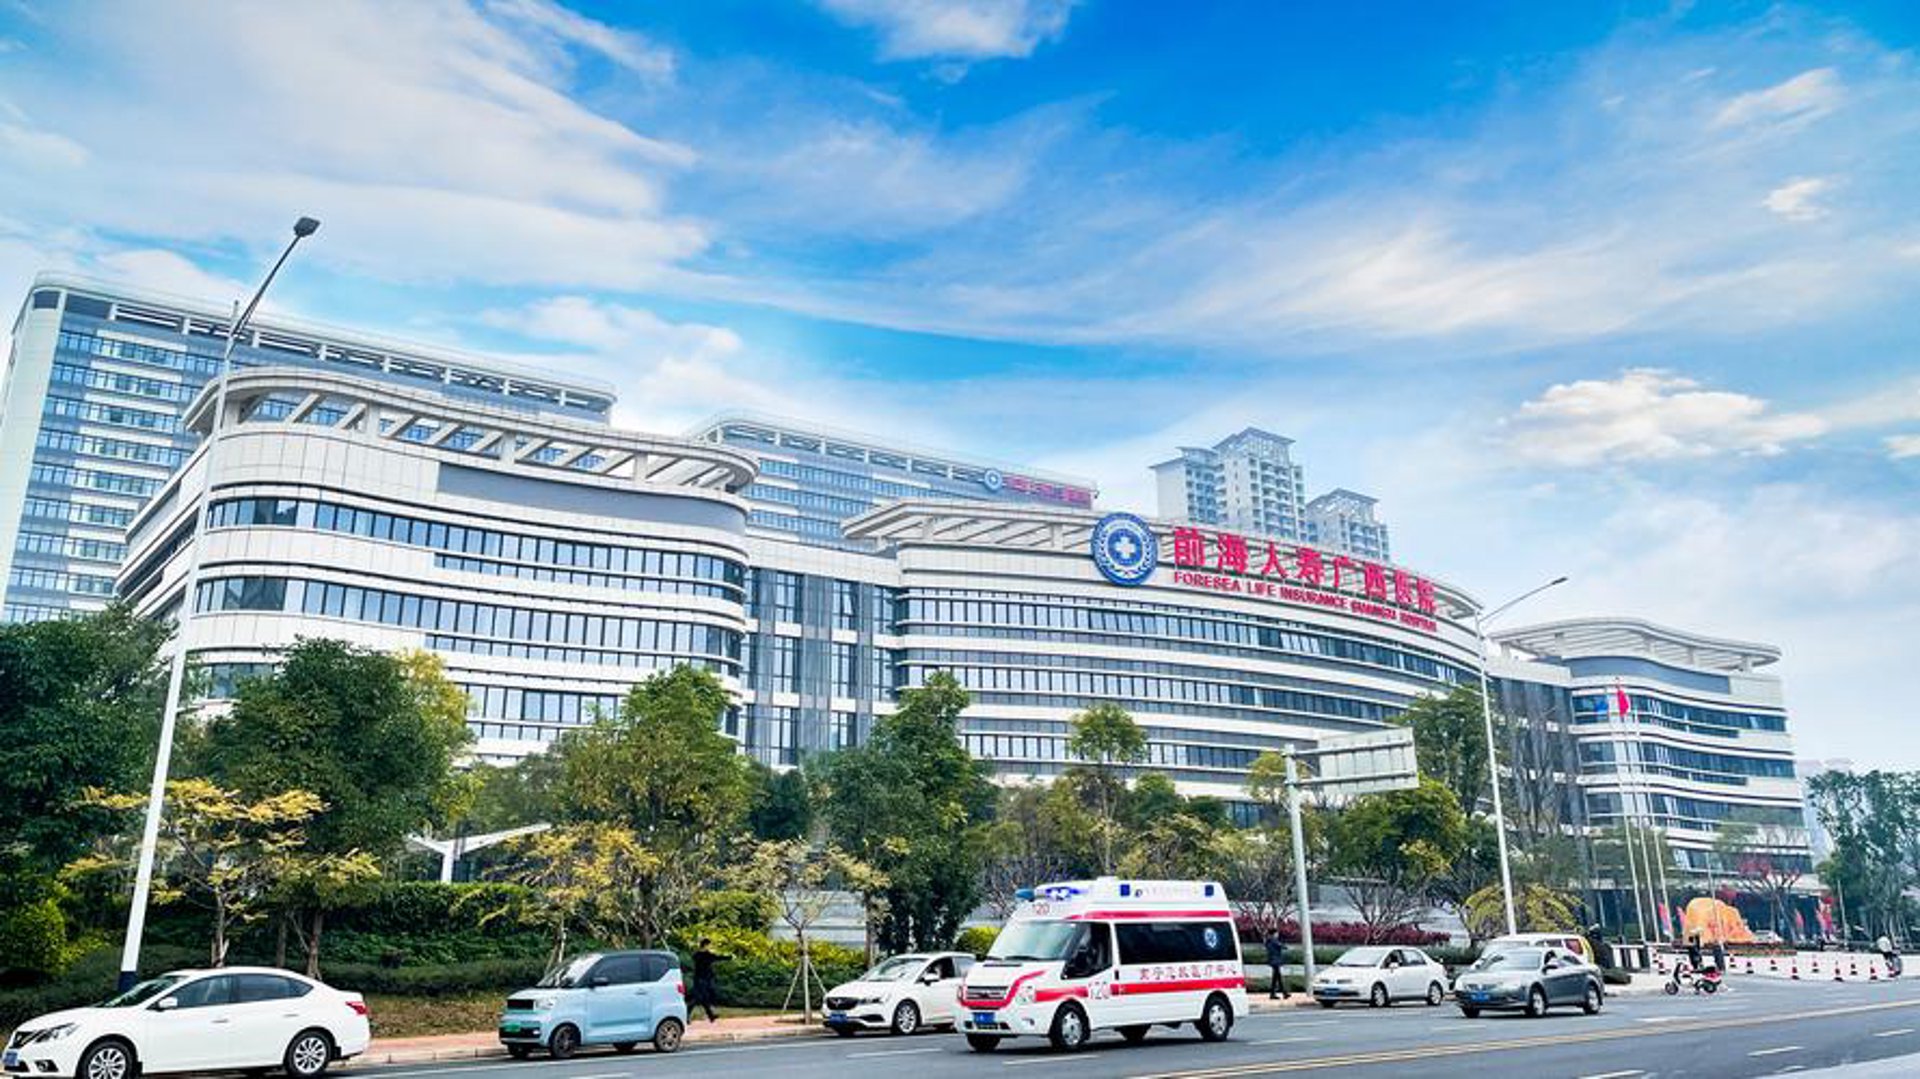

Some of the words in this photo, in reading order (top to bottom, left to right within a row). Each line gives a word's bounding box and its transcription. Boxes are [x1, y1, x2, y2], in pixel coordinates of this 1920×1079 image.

[1174, 527, 1435, 614] 前海人寿广西医院
[1174, 571, 1241, 592] FORESEA
[1247, 581, 1277, 596] LIFE
[1280, 586, 1347, 609] INSURANCE
[1032, 903, 1050, 916] 120
[1088, 981, 1110, 1000] 120
